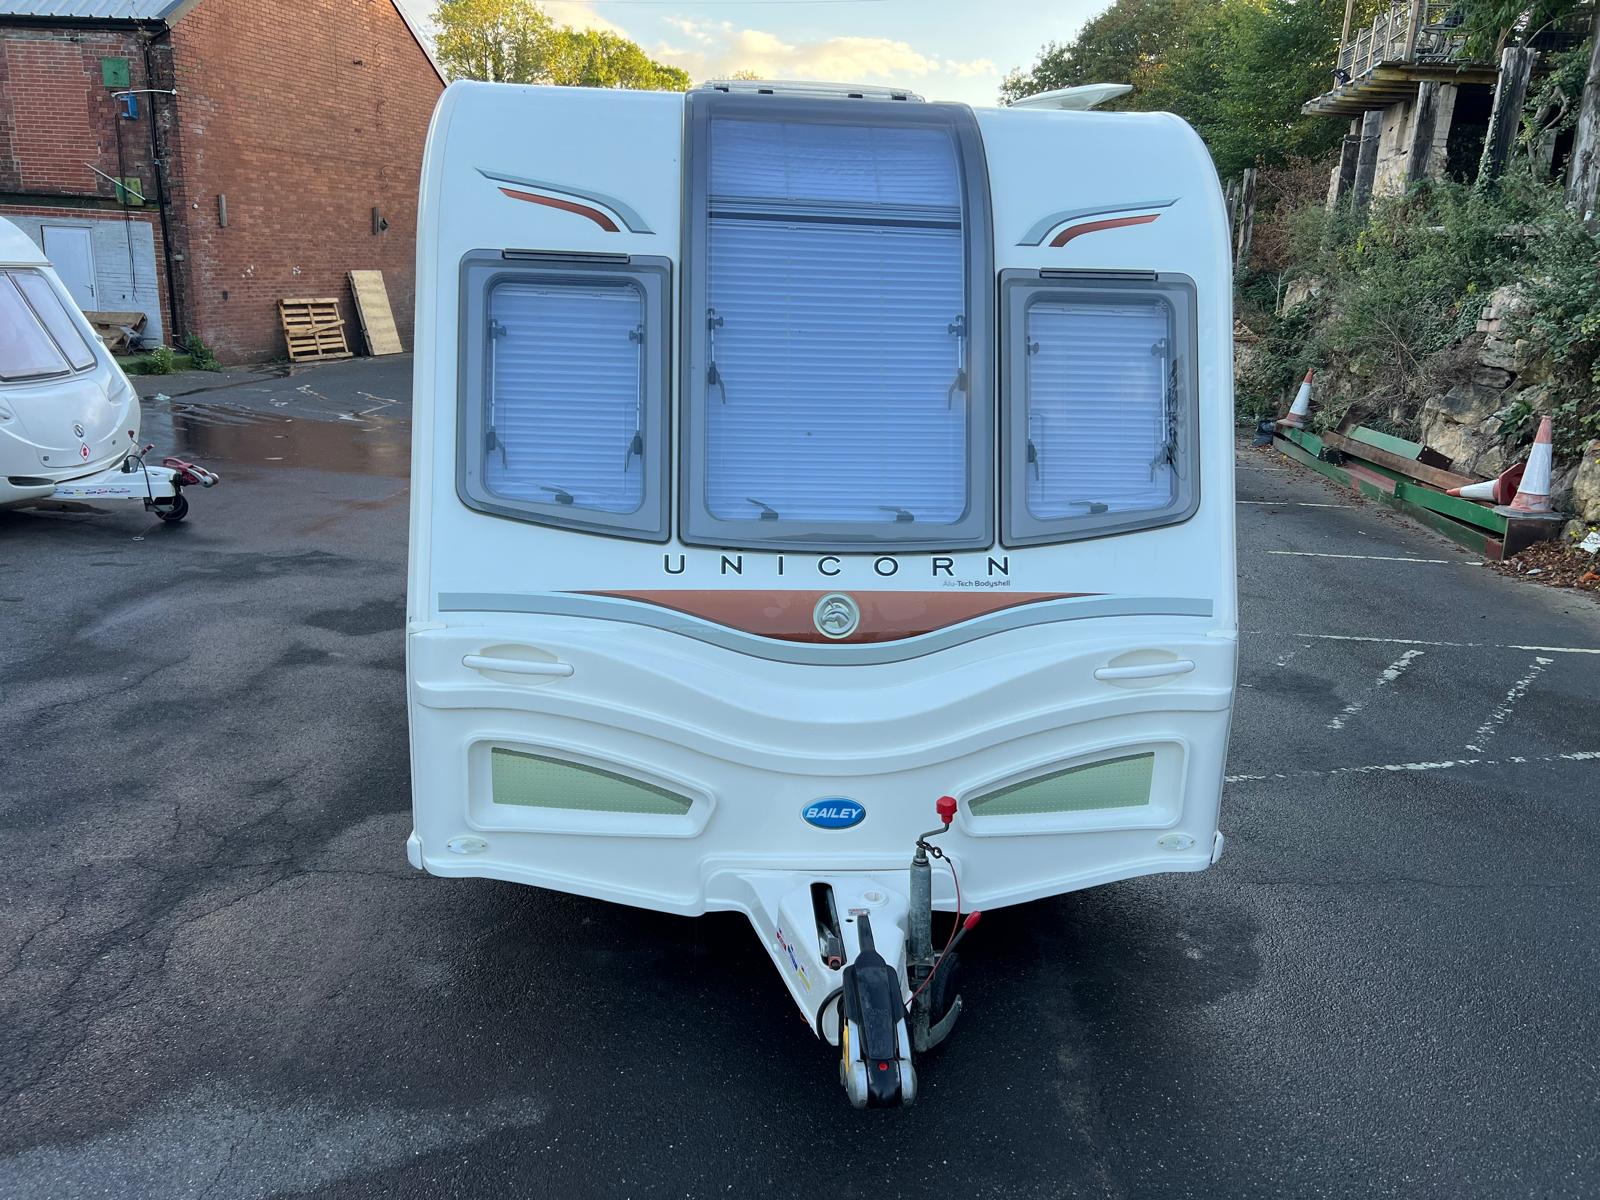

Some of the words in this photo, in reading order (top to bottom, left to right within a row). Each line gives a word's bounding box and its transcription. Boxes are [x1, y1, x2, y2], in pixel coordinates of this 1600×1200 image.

[664, 554, 1009, 576] UNICORN
[974, 580, 1011, 588] Bodyshell
[805, 807, 862, 819] BAILEY
